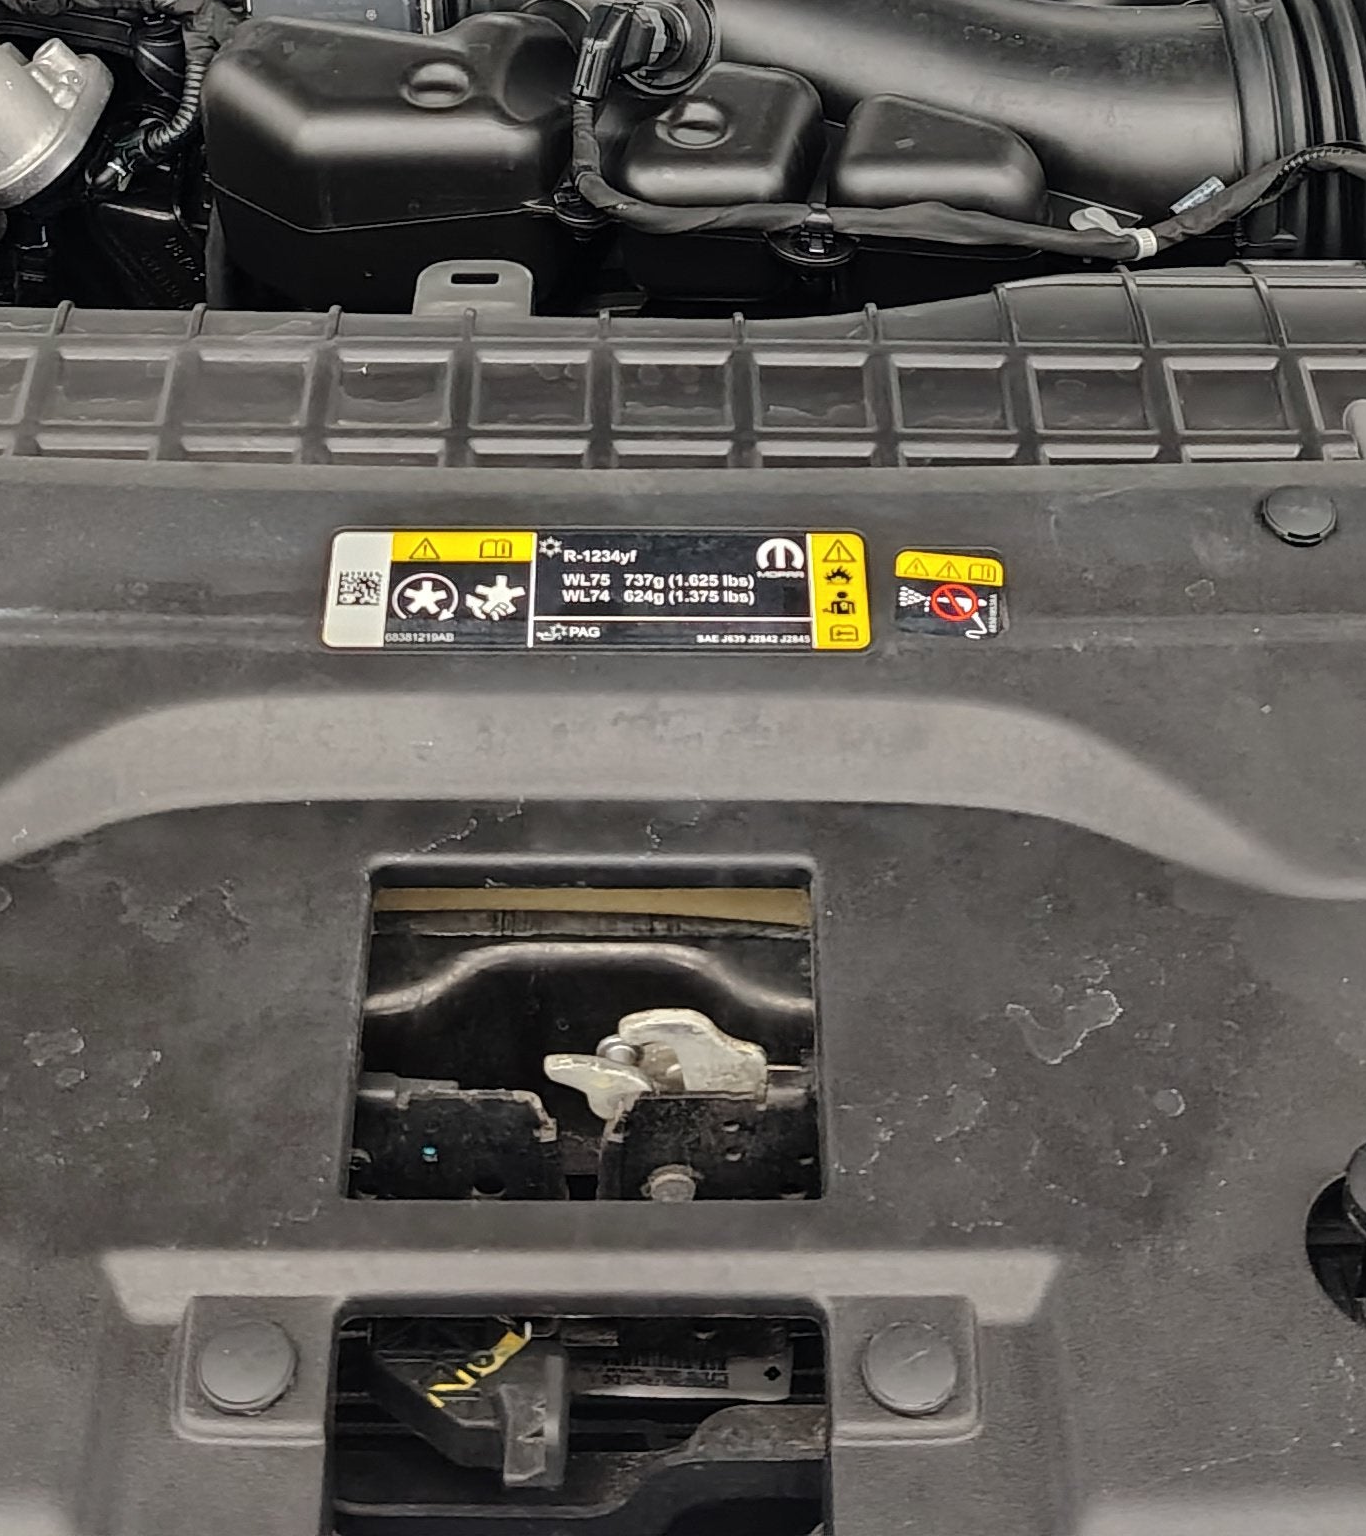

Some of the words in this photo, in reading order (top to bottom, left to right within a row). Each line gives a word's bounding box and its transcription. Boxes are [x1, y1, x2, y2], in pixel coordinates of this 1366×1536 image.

[562, 549, 638, 566] R-1234yf
[561, 573, 611, 587] WL75
[622, 573, 665, 590] 737g
[668, 573, 719, 589] (1.625
[722, 573, 755, 589] lbs)
[561, 589, 611, 603] WL74
[622, 589, 665, 605] 624g
[668, 589, 719, 605] (1.375
[722, 589, 755, 605] lbs)
[568, 627, 601, 638] PAG
[696, 634, 720, 643] SAE
